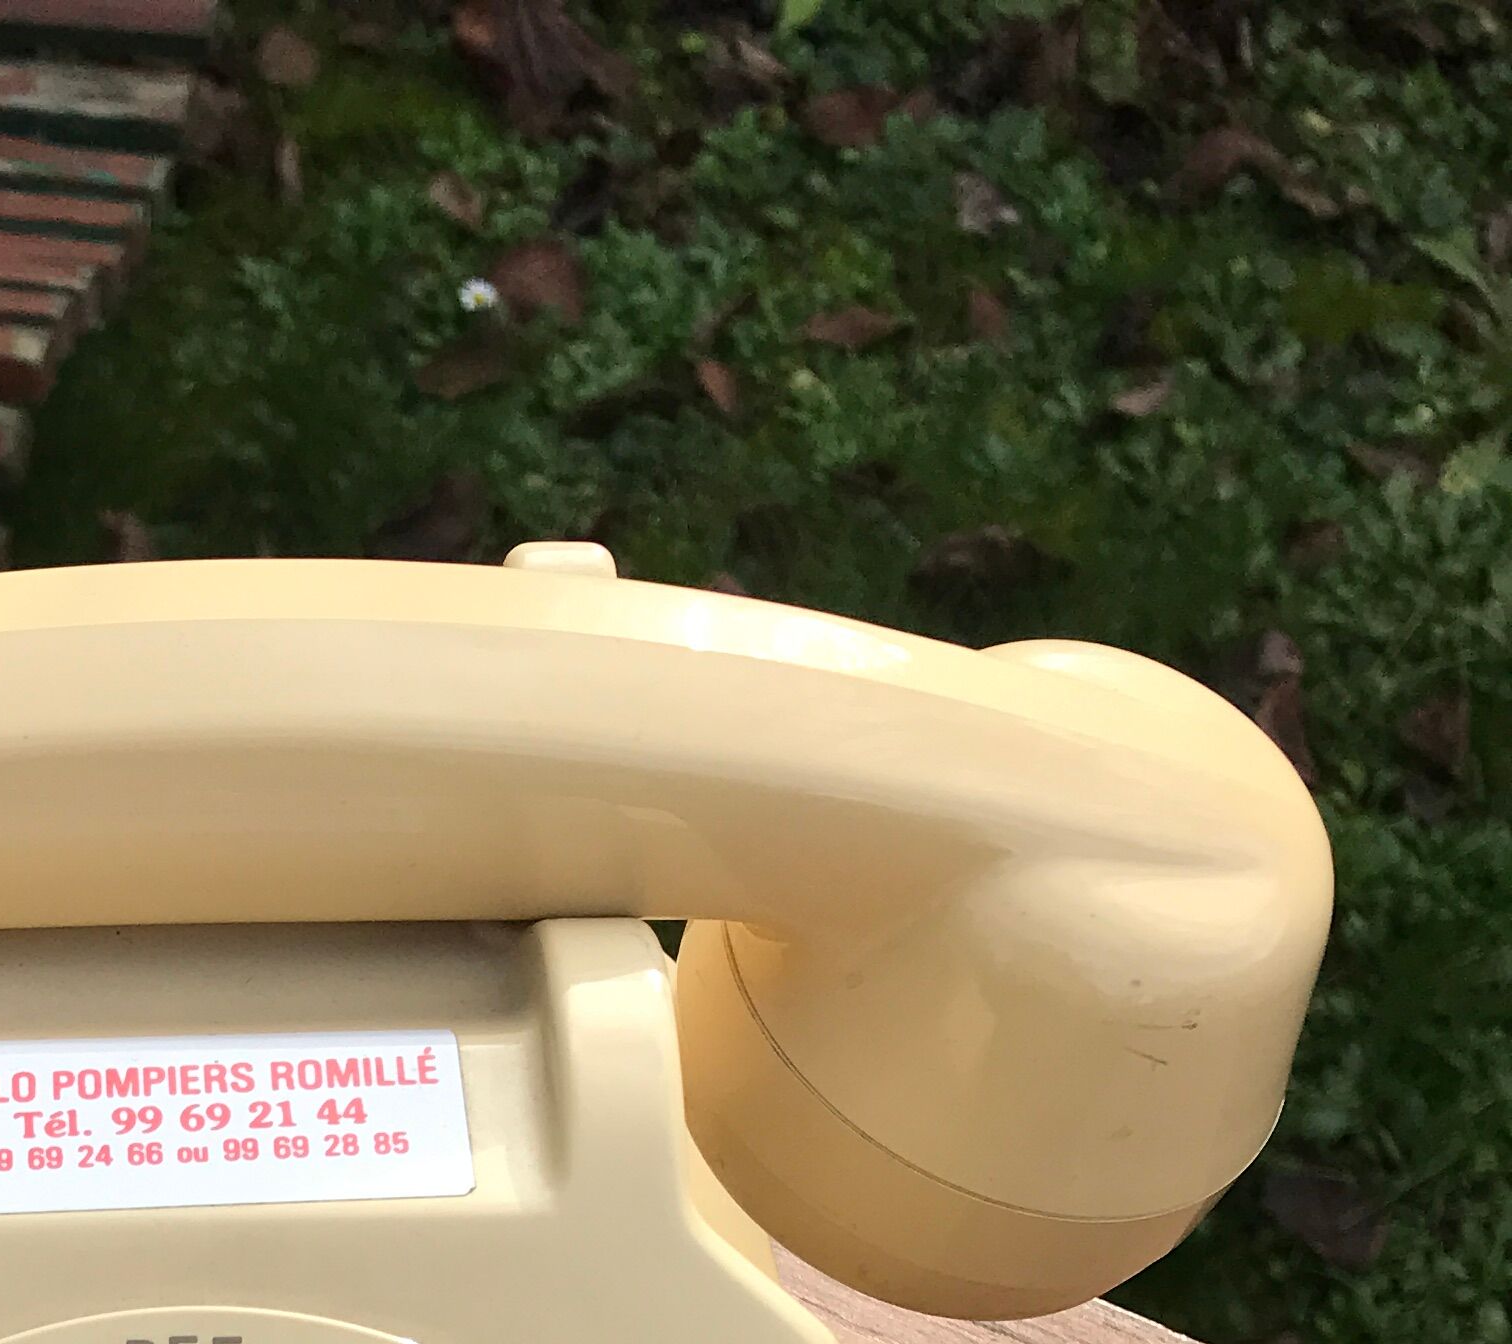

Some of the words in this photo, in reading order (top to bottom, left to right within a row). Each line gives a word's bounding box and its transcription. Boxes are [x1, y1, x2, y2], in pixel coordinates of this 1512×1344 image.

[52, 1061, 256, 1101] POMPIERS
[271, 1048, 440, 1090] ROMILLÉ
[13, 1109, 92, 1139] Tél.
[111, 1106, 163, 1136] 99
[180, 1103, 231, 1132] 69
[248, 1102, 296, 1129] 21
[316, 1098, 368, 1125] 44
[27, 1146, 63, 1170] 69
[77, 1145, 114, 1168] 24
[126, 1142, 164, 1166] 66
[176, 1144, 209, 1164] ou
[222, 1138, 260, 1161] 99
[273, 1136, 310, 1159] 69
[324, 1134, 360, 1156] 28
[374, 1132, 410, 1154] 85
